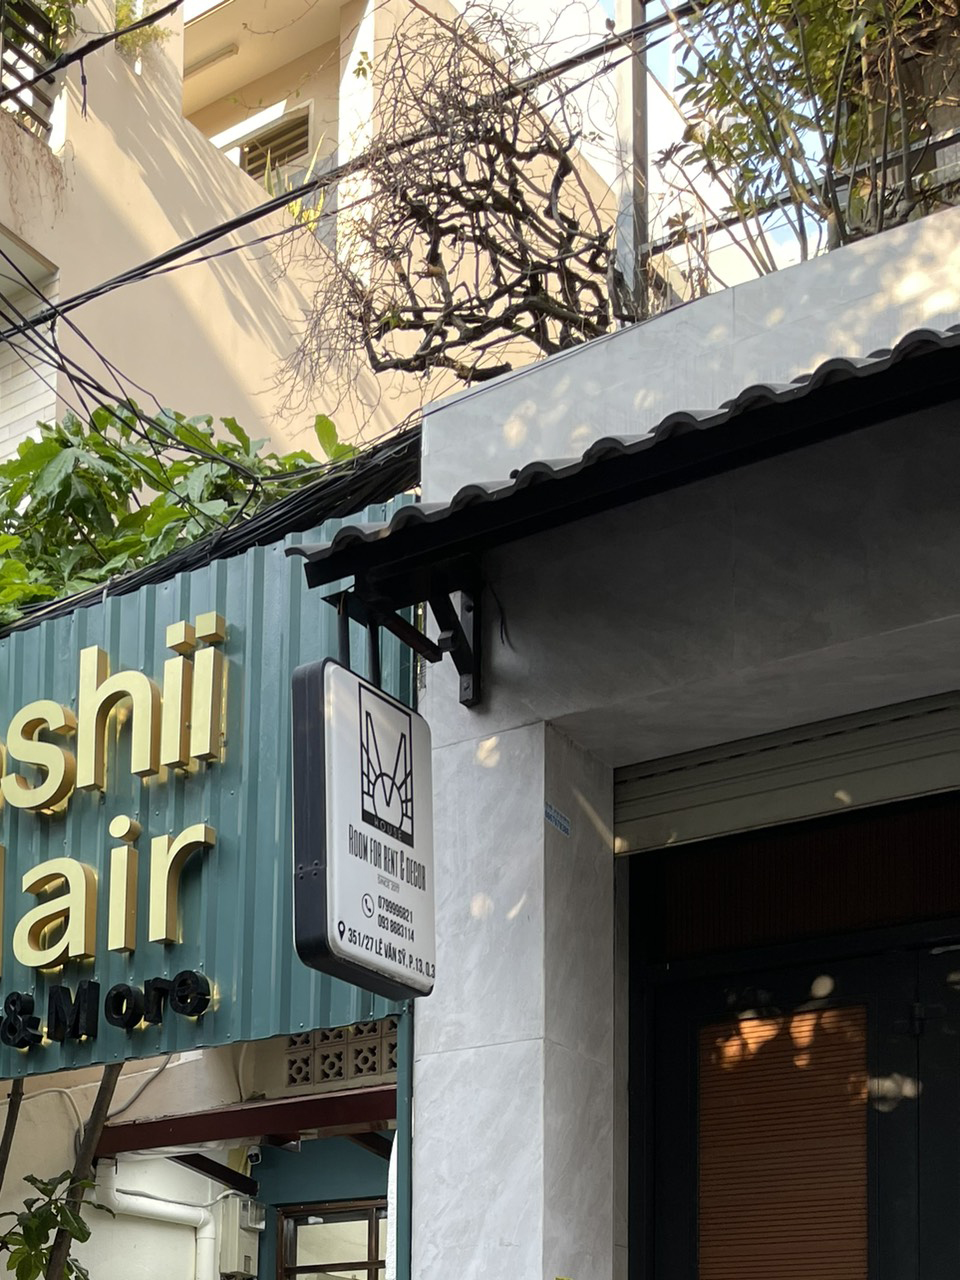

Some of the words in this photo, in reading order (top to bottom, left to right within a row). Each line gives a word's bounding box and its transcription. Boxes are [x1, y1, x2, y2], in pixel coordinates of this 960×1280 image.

[373, 817, 403, 842] HOUSE
[349, 824, 369, 862] ROOM
[370, 838, 382, 869] FOR
[384, 845, 398, 878] RENT
[406, 857, 426, 891] DECOR
[348, 927, 374, 952] 351/27
[375, 938, 382, 956] LÊ
